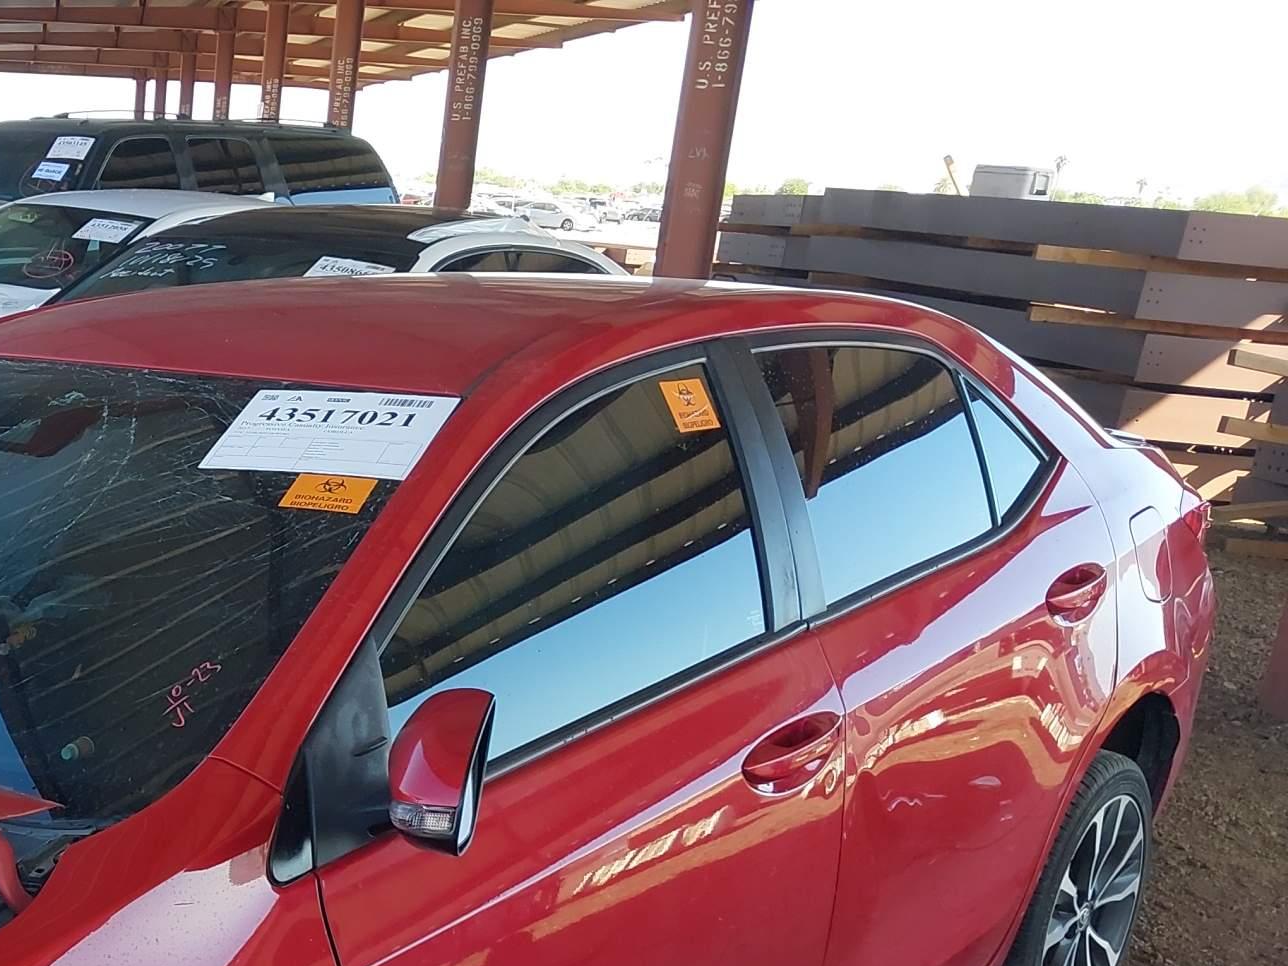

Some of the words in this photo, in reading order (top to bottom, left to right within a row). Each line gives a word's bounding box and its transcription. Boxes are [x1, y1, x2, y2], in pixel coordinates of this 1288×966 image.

[711, 0, 738, 89] 1-866-79
[454, 45, 470, 93] PREFAB
[258, 405, 418, 428] 43517021
[289, 500, 350, 511] BIOPELIGRO
[294, 494, 353, 505] BIOHAZARD
